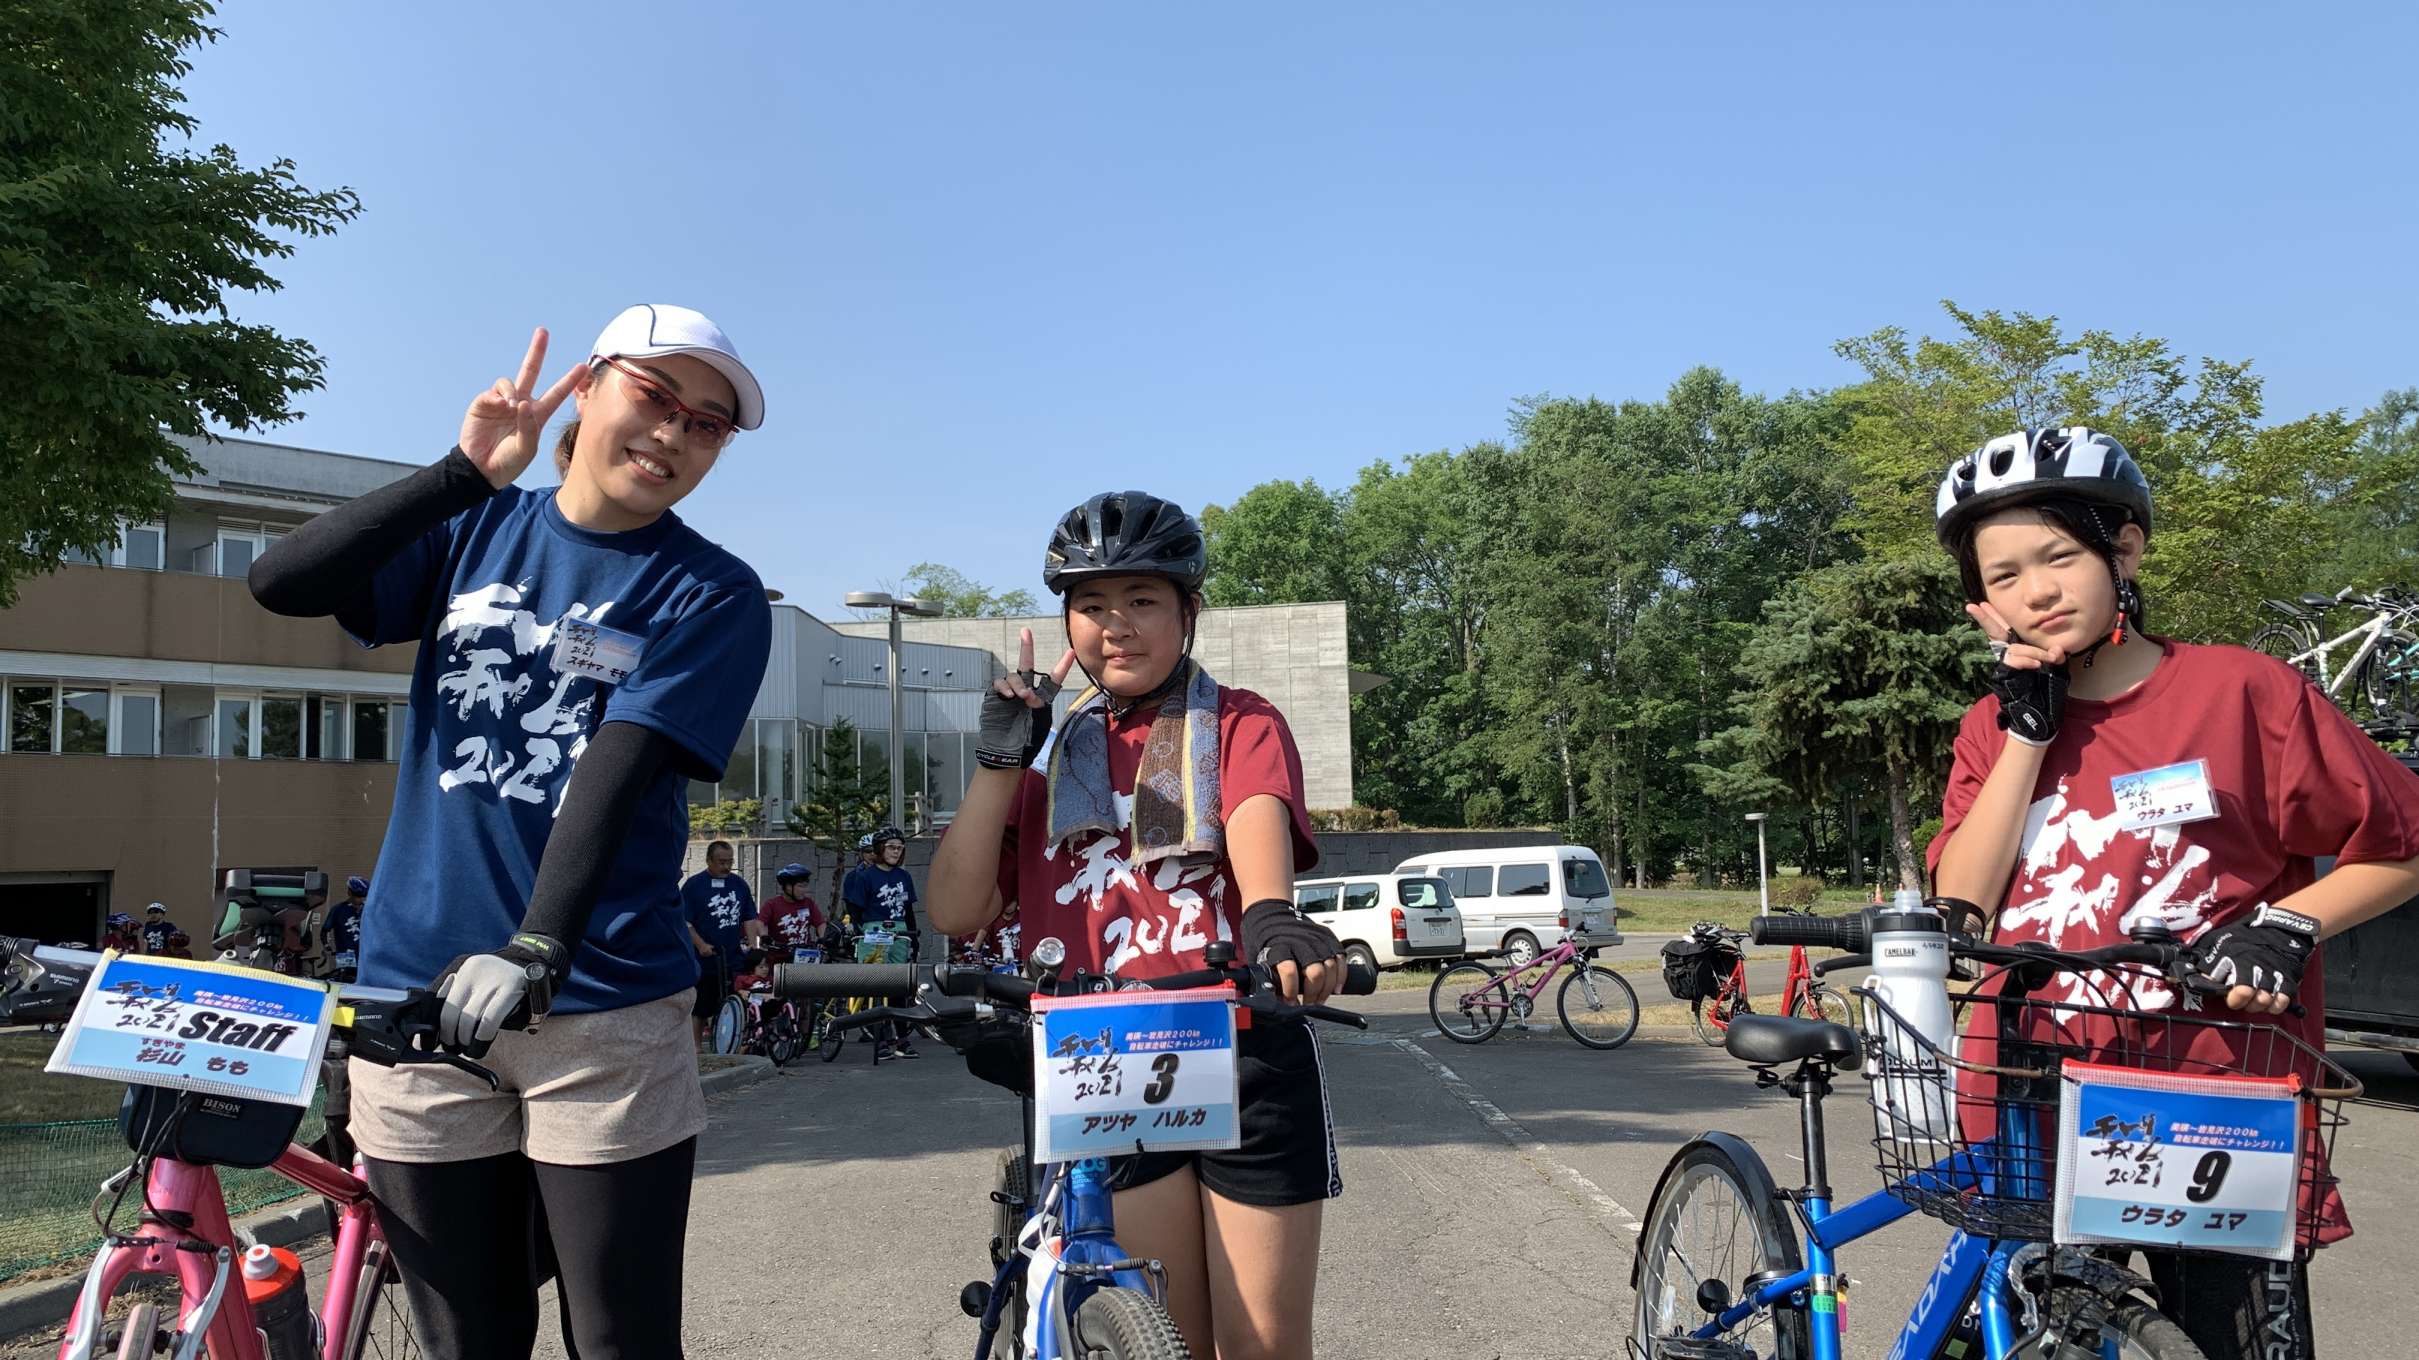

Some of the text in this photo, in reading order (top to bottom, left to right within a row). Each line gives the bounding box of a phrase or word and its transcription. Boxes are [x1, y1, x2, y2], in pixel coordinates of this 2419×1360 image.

[566, 656, 605, 672] スギヤマ
[2022, 712, 2038, 731] GEL
[2137, 802, 2194, 821] ウラタ ユマ
[142, 1037, 186, 1050] すぎやま
[178, 1010, 300, 1053] Staff
[136, 1047, 250, 1076] 杉山 もも
[1143, 1053, 1180, 1105] 3
[203, 1098, 240, 1113] BISON
[1081, 1108, 1207, 1136] アツヤ ハルカ
[2186, 1150, 2232, 1204] 9
[2121, 1205, 2248, 1232] ウラタ ユマ
